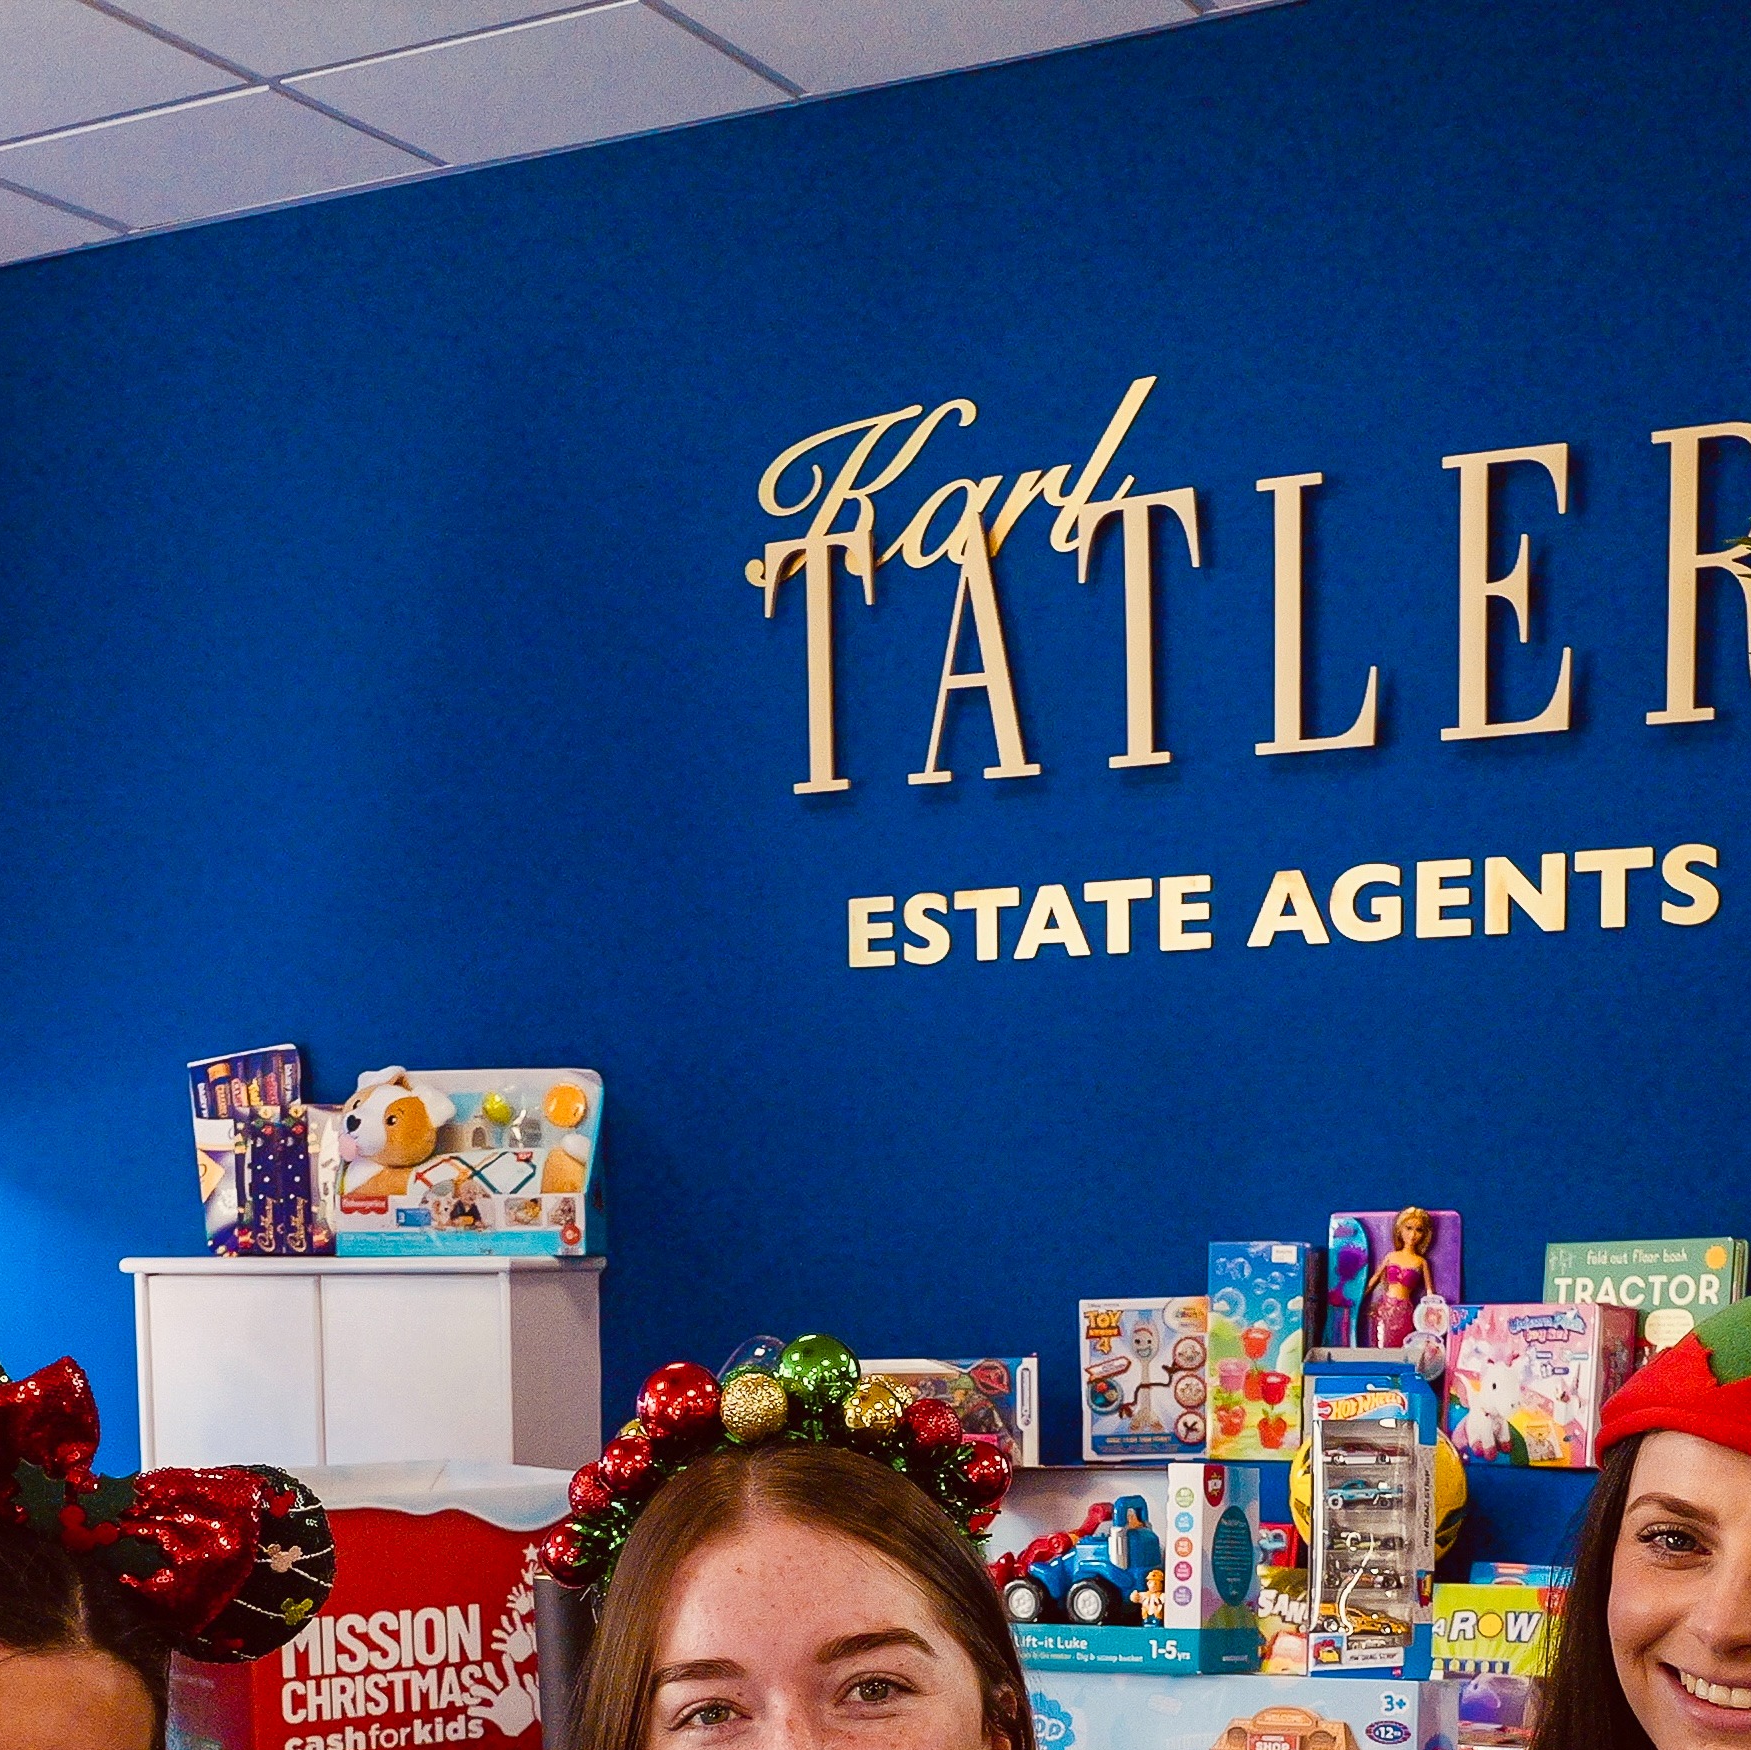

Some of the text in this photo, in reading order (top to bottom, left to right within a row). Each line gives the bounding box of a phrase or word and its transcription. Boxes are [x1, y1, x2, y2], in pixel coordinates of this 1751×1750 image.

[743, 375, 1158, 588] Karl
[847, 842, 1722, 968] ESTATE AGENTS
[1586, 1248, 1609, 1266] fold
[1662, 1248, 1688, 1264] book
[1553, 1273, 1721, 1307] TRACTOR
[1085, 1309, 1123, 1330] TOY
[1333, 1399, 1359, 1420] HOT
[281, 1603, 483, 1679] MISSION
[1449, 1610, 1543, 1642] ROW
[1057, 1636, 1089, 1650] Luke
[281, 1663, 484, 1724] CHRISTMAS
[1382, 1693, 1408, 1713] 3+
